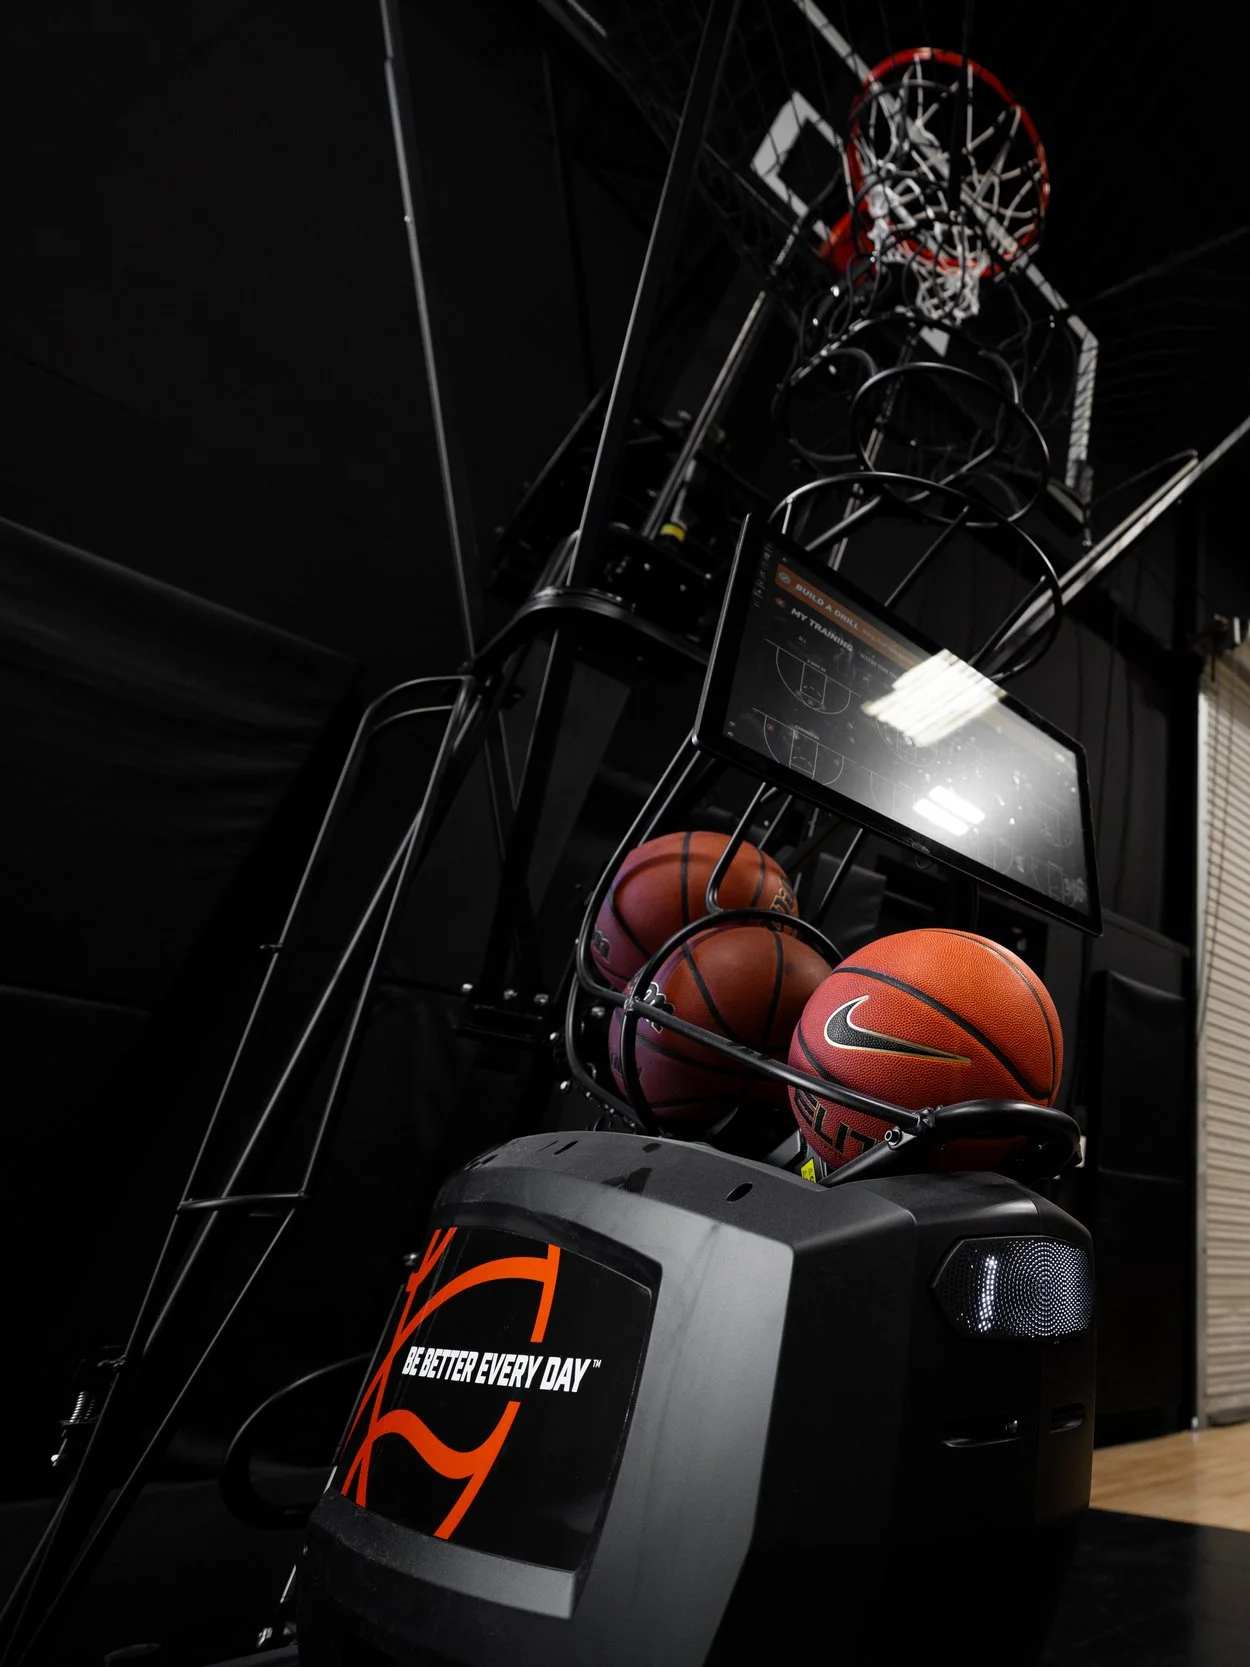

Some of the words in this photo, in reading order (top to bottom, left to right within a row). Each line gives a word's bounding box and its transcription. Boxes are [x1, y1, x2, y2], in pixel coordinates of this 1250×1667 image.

[791, 607, 809, 621] MY
[809, 618, 854, 652] TRAINING
[795, 583, 824, 606] BUILD
[825, 604, 833, 613] A
[834, 609, 860, 631] DRILL
[402, 1346, 425, 1376] BE
[418, 1347, 479, 1383] BETTER
[474, 1352, 543, 1389] EVERY
